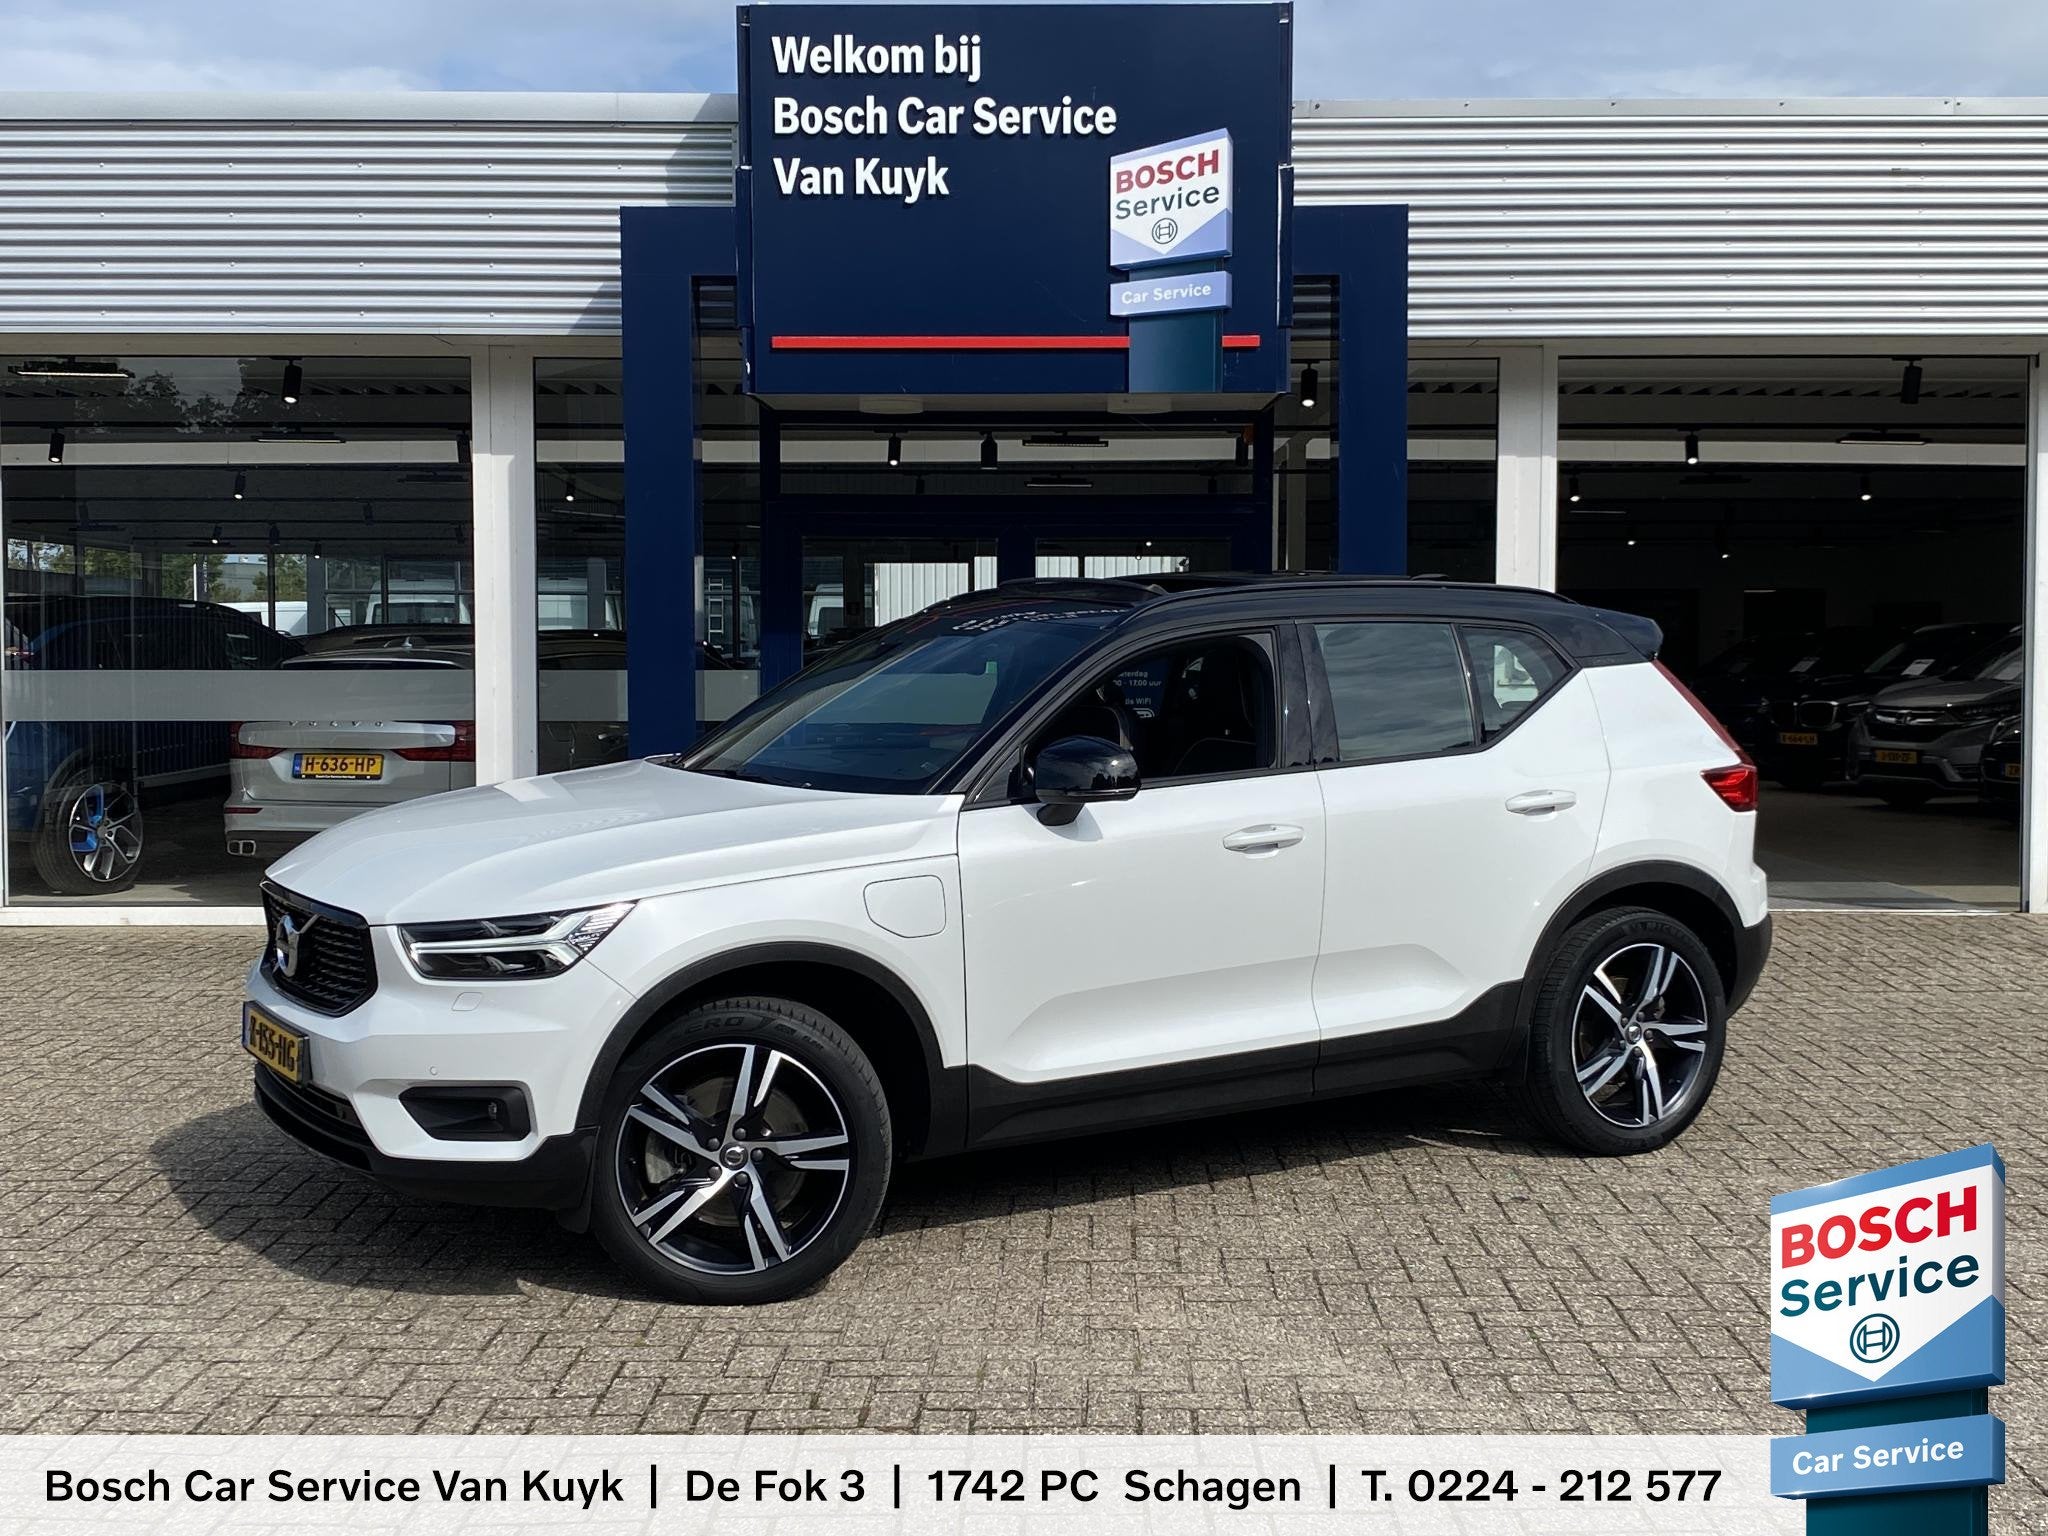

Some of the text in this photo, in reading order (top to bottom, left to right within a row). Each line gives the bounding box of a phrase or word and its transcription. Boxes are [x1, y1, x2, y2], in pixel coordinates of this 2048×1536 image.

[772, 34, 981, 83] Welkom bij
[774, 95, 1117, 135] Bosch Car Service
[773, 156, 950, 204] Van Kuyk
[1116, 149, 1220, 194] BOSCH
[1115, 185, 1220, 220] Service
[1121, 283, 1212, 305] Car Service
[304, 757, 377, 773] H-636-HP
